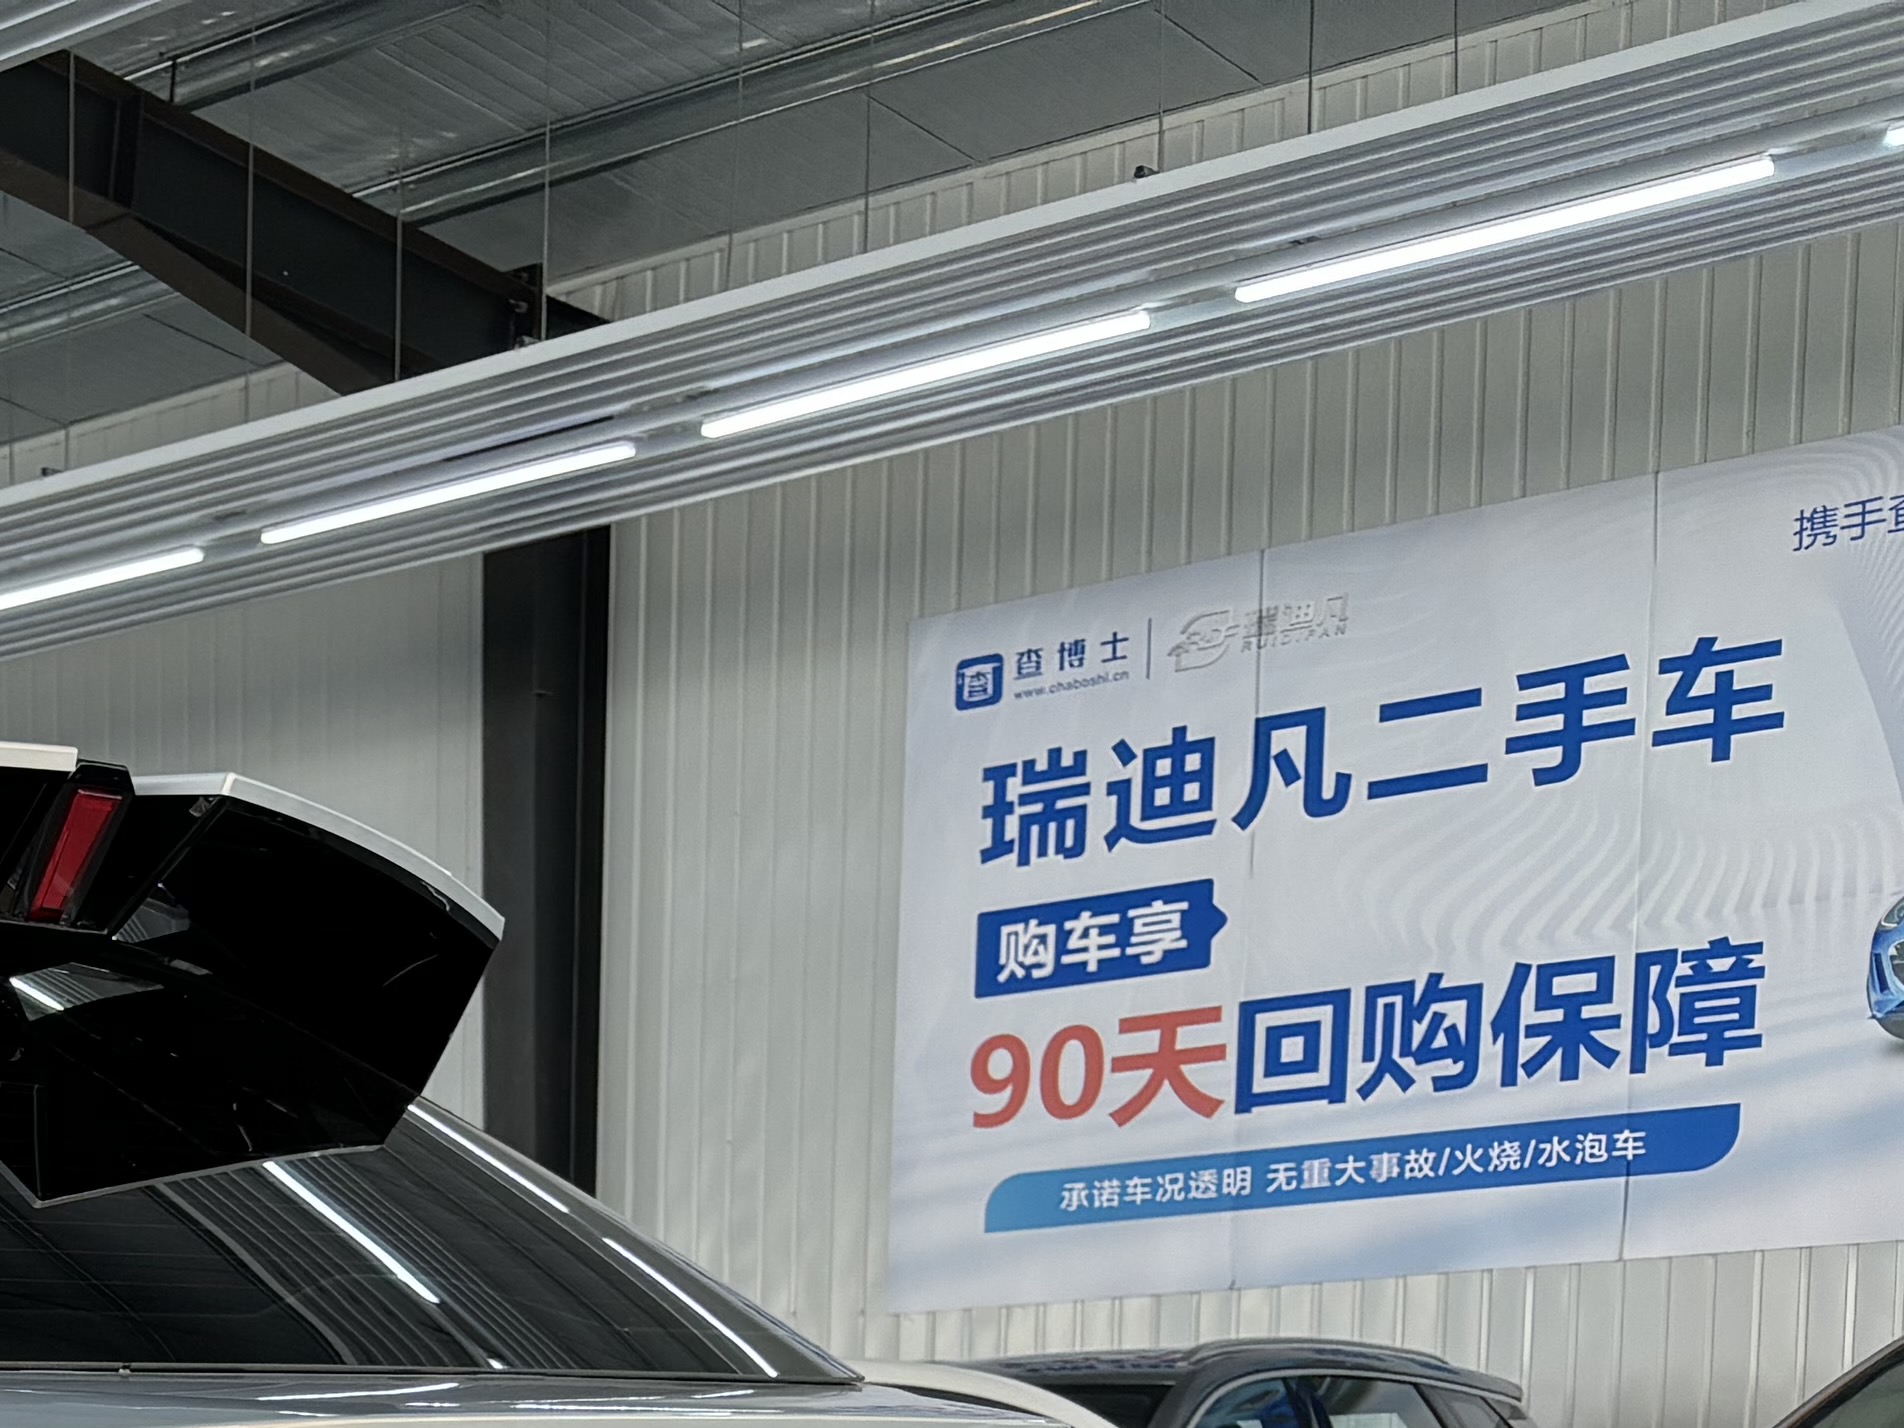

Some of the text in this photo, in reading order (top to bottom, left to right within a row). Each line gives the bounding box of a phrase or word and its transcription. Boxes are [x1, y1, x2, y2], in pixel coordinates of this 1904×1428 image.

[1013, 670, 1130, 701] www.chaboshi.cn
[1014, 631, 1130, 681] 查博士
[979, 637, 1786, 868] 瑞迪凡二手车
[996, 899, 1190, 984] 购车享
[969, 937, 1767, 1130] 90天回购保障
[1059, 1129, 1647, 1212] 承诺车况透明 无重大事故/火烧/水泡车
